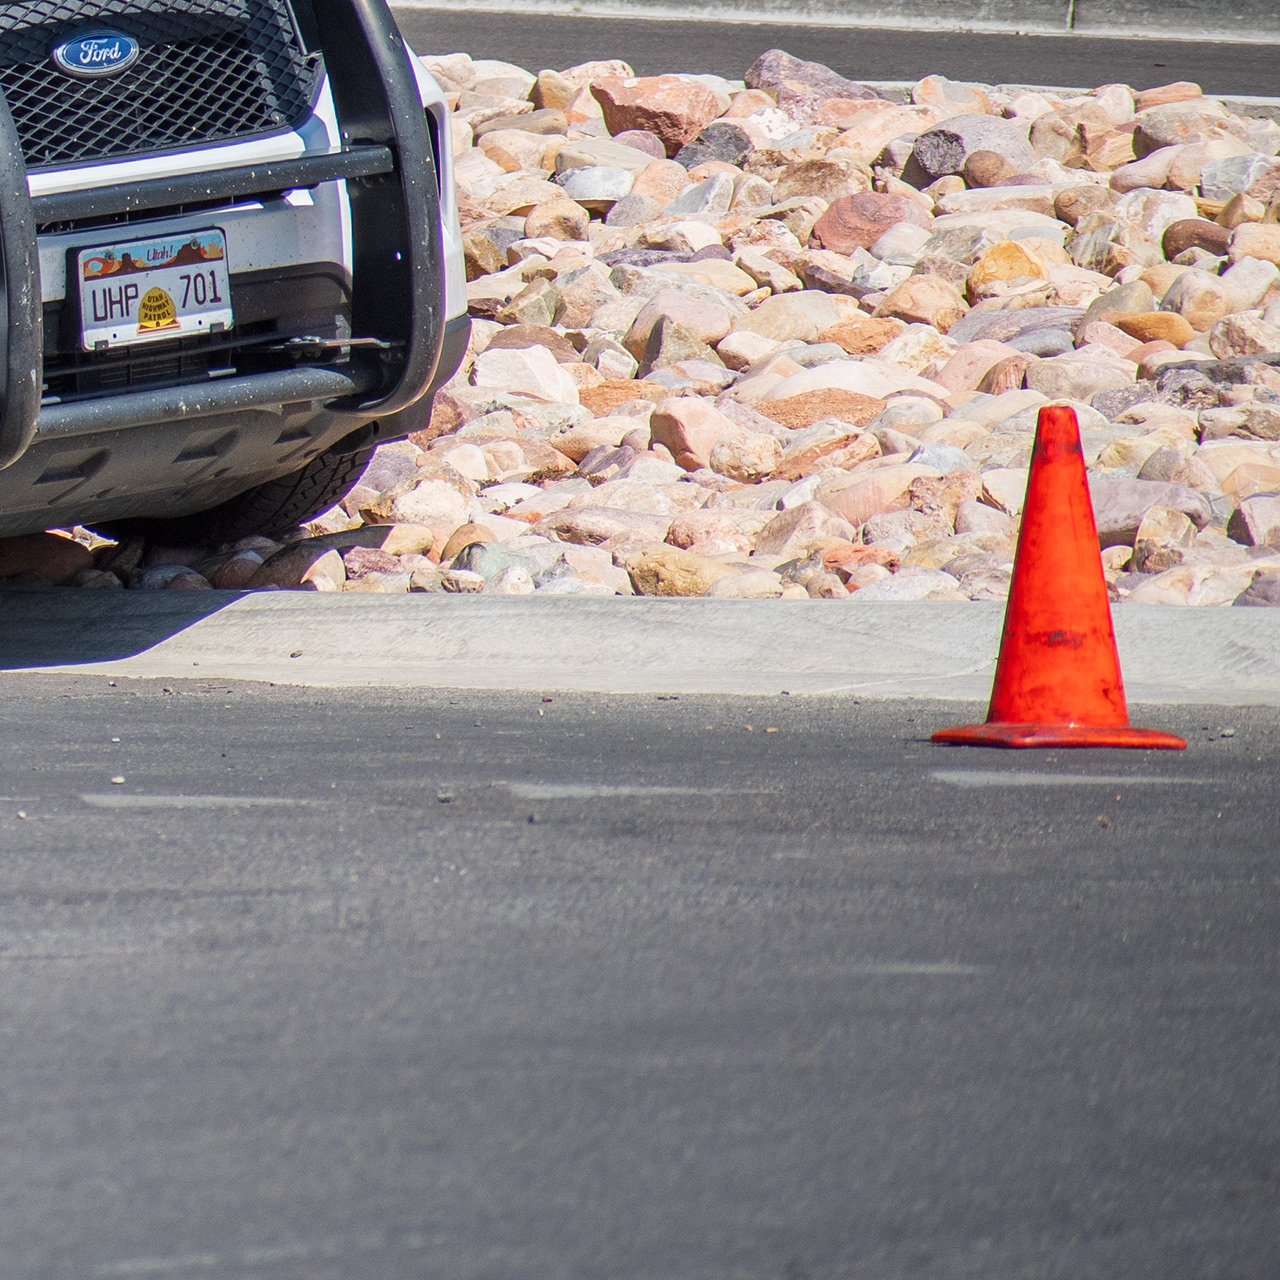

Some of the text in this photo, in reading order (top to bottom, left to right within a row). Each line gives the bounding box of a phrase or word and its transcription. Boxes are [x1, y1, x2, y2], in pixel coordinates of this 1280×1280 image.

[79, 38, 122, 64] Ford
[146, 244, 174, 263] Utah!
[92, 269, 223, 323] UHP 701
[147, 293, 164, 304] UTAH
[141, 299, 171, 312] HIGHWAY
[143, 309, 172, 322] PATROL
